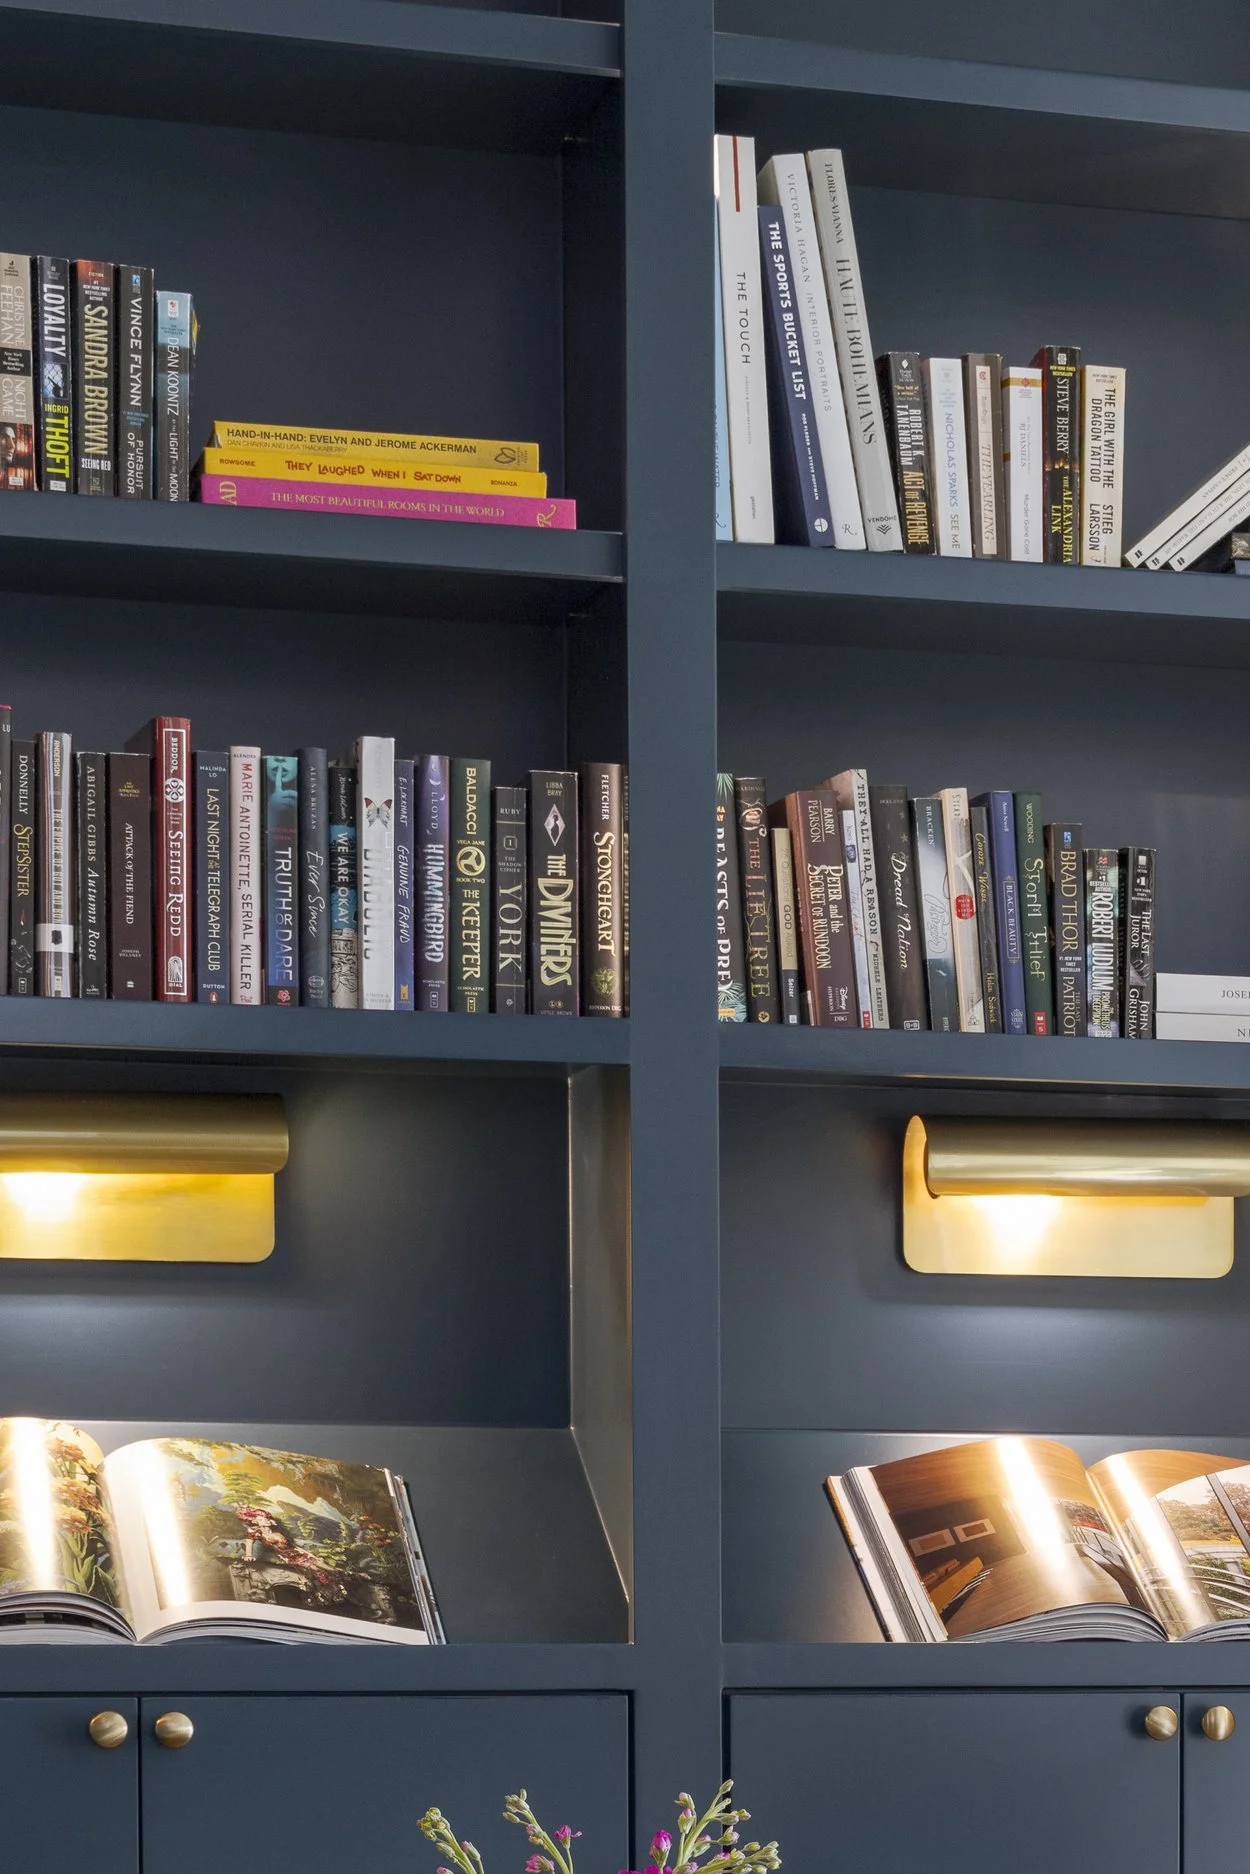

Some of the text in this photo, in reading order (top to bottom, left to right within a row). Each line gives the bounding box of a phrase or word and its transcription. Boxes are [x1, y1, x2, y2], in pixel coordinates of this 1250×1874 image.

[787, 173, 811, 283] VICTORIA HAGAN
[736, 272, 748, 301] THE
[768, 221, 807, 400] THE SPORTS BUCKET LIST
[0, 284, 14, 345] FEEHAN
[13, 285, 26, 346] CHRISTINE
[43, 283, 66, 358] LOYALTY
[130, 297, 142, 350] VINCE
[738, 308, 751, 364] TOUCH
[84, 303, 109, 456] SANDRA BROWN
[167, 336, 179, 368] DEAN
[806, 292, 832, 412] INTERIOR PORTRAITS
[14, 380, 27, 421] NIGHT
[130, 353, 142, 407] FLYNN
[167, 370, 179, 416] KOONTZ
[1104, 388, 1116, 408] THE
[44, 403, 69, 414] INGRID
[896, 404, 913, 466] TANENBAUM
[909, 409, 924, 446] ROBERT
[1056, 377, 1070, 453] STEVE BERRY
[1104, 412, 1115, 435] GIRL
[45, 415, 70, 479] THOFT
[81, 457, 100, 470] SEEING
[127, 432, 135, 494] OF HONOR
[135, 439, 144, 490] PURSUIT
[169, 432, 179, 461] LIGHT
[219, 458, 256, 467] ROWSOME
[227, 428, 477, 454] HAND-IN-HAND: EVELYN AND JEROME ACKERMAN
[945, 412, 956, 469] NICHOLAS
[1090, 398, 1103, 483] DRAGON TATTOO
[1103, 438, 1115, 466] WITH
[285, 460, 461, 484] THEY LAUGHED WHEN SAT DOWN
[948, 472, 958, 507] SPARKS
[1102, 470, 1115, 489] THE
[272, 492, 505, 517] THE MOST BEAUTIFUL ROOMS IN THE WORLD
[903, 471, 929, 544] ACT REVENGE
[950, 514, 961, 549] SEE ME
[982, 474, 995, 540] YEARLING
[1051, 505, 1061, 533] LINK
[1063, 488, 1073, 564] ALEXANDRIA
[1089, 503, 1101, 551] LARSSON
[1102, 504, 1113, 535] STIEG
[19, 755, 28, 815] DONNELLY
[431, 792, 439, 829] LLOYD
[466, 767, 477, 835] BALDACCI
[601, 774, 610, 820] FLETCHER
[87, 765, 96, 862] ABIGAIL GIBBS
[206, 788, 220, 860] LAST NIGHT
[807, 800, 822, 843] PEARSON
[823, 807, 835, 835] BARRY
[925, 806, 935, 848] BRACKEN
[1025, 803, 1034, 844] WOODING
[125, 822, 134, 925] ATTACK THE FIEND
[237, 763, 254, 990] MARIE ANTOINETTE, SERIAL KILLER
[275, 846, 292, 910] TRUTH
[337, 832, 349, 924] WE ARE OKAY
[749, 838, 760, 868] THE
[857, 784, 878, 935] THEY ALL HAD REASON
[87, 868, 100, 961] Autumn Rose
[167, 893, 183, 937] REDD
[207, 870, 220, 971] TELEGRAPH CLUB
[306, 850, 326, 938] Ever Since
[397, 844, 410, 943] GENUINE FRAUD
[425, 844, 445, 963] HUMMINGBIRD
[462, 889, 480, 899] THE
[537, 854, 576, 986] THE DIVINERS
[783, 905, 792, 930] GOD
[807, 863, 832, 969] SECRET OF RUNDOON
[826, 865, 844, 933] PETER and the
[890, 851, 912, 969] Dread Nation
[1006, 885, 1017, 955] BLACK BEAUTY
[1060, 851, 1079, 953] BRAD THOR
[1091, 892, 1114, 940] ROBERT
[275, 929, 293, 981] DARE
[462, 901, 481, 981] KEEPER
[499, 884, 522, 973] YORK
[1129, 914, 1141, 949] JUROR
[1141, 909, 1152, 956] THE LAST
[1091, 943, 1114, 991] LUDLUM
[1063, 976, 1076, 1037] PATRIOT
[1138, 1000, 1150, 1031] JOHN
